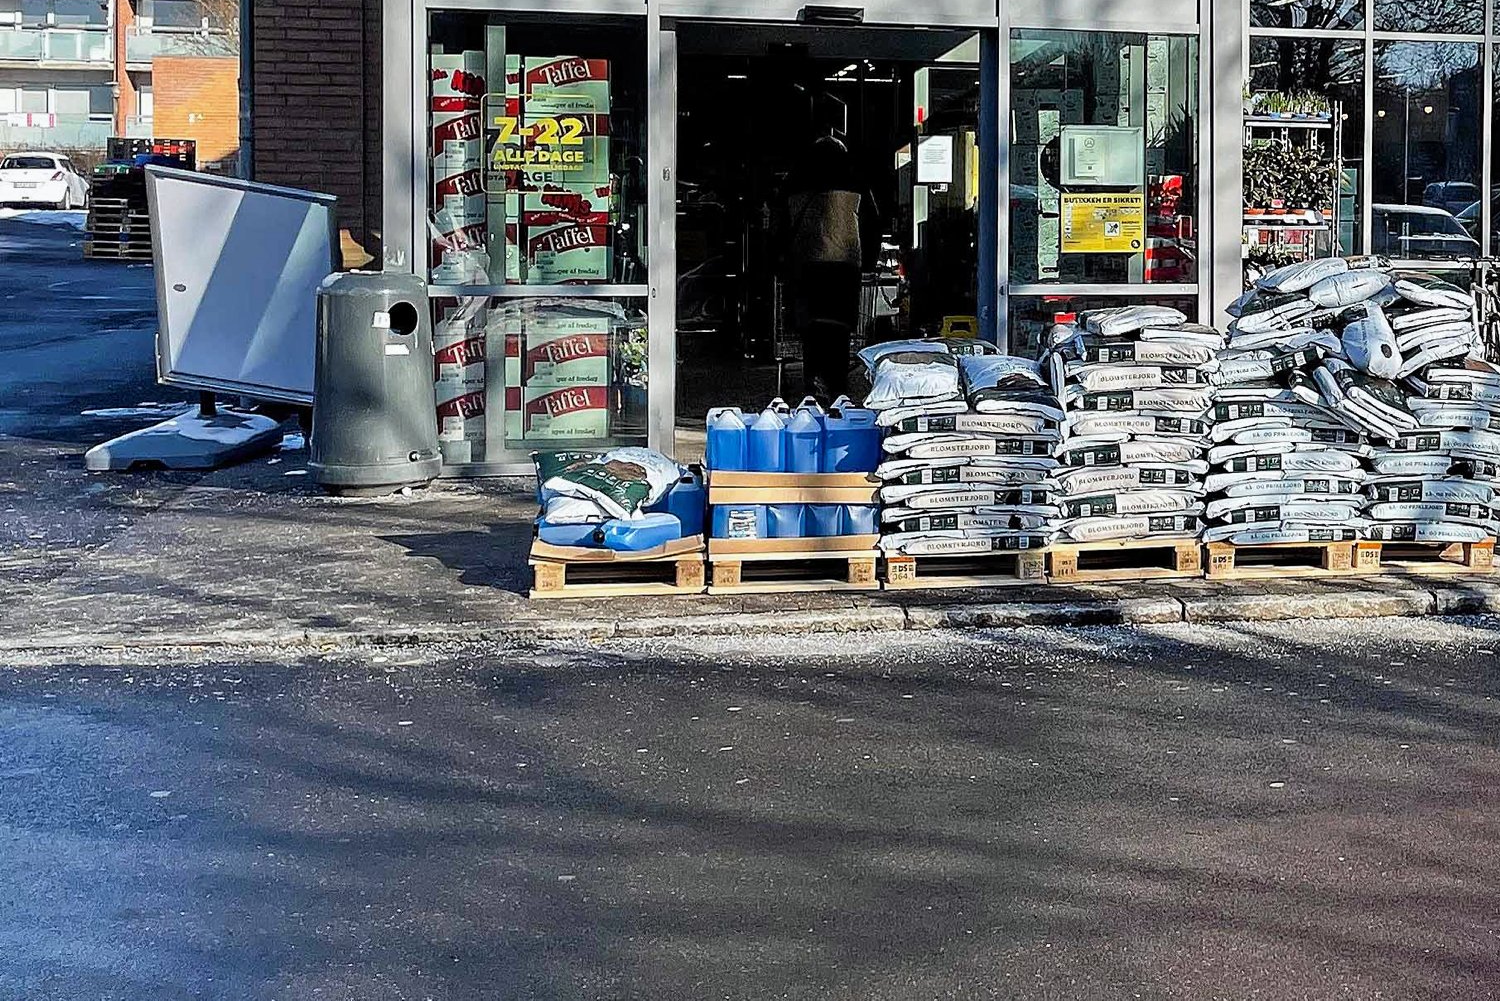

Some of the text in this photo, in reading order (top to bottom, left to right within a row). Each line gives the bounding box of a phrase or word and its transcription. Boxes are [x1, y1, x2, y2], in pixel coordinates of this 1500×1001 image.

[539, 60, 592, 87] Taffel
[494, 117, 584, 144] 7-22
[494, 150, 584, 163] ALLE DAGE
[543, 226, 595, 252] Taffel
[540, 337, 594, 363] Taffel
[539, 389, 592, 415] Taffel
